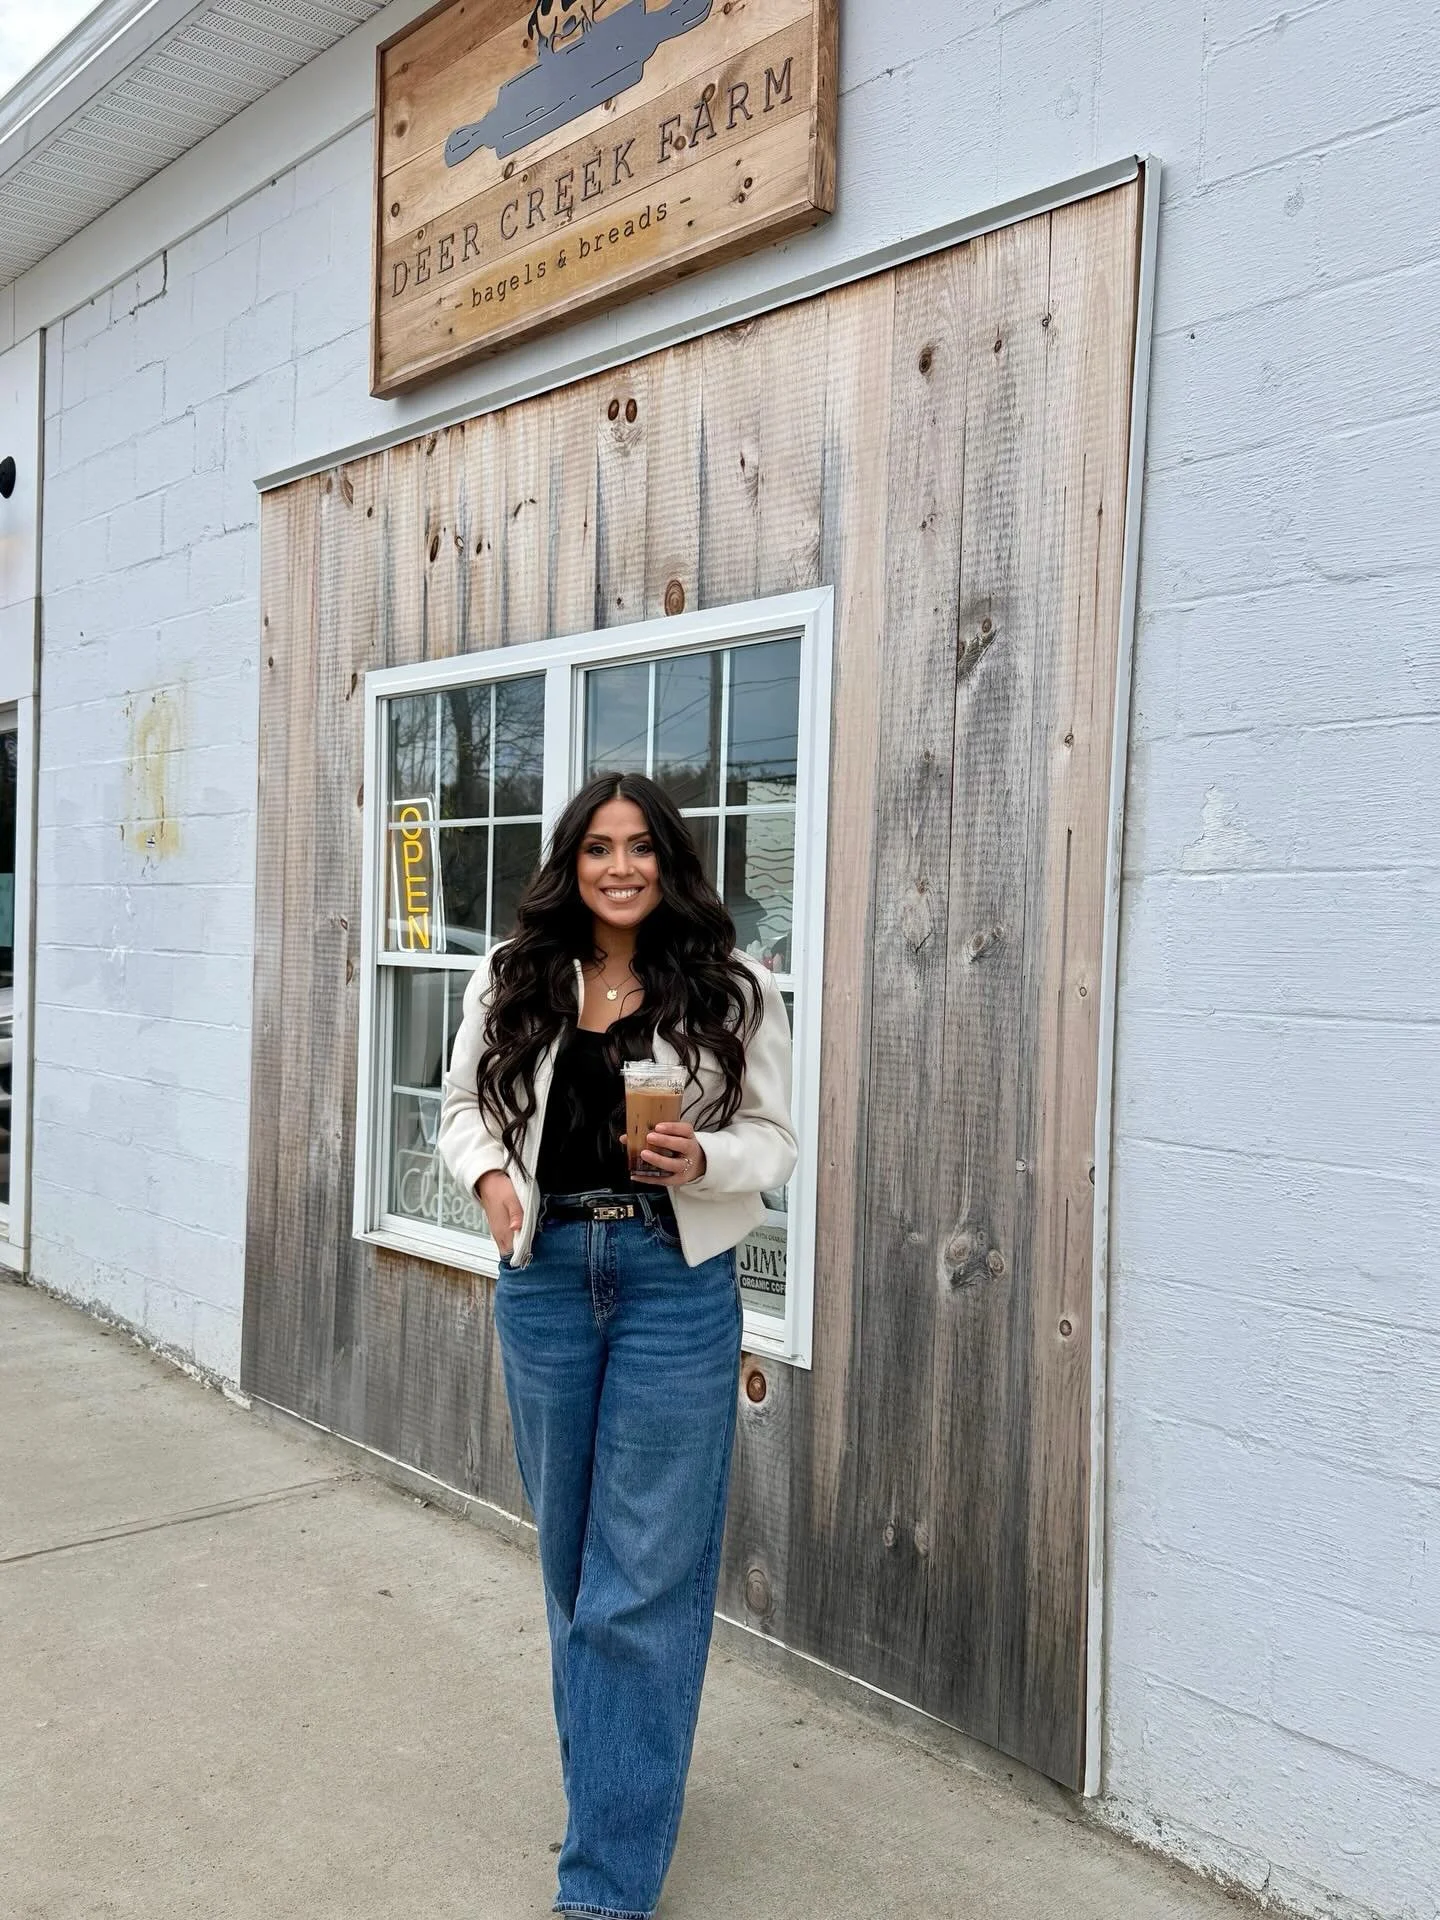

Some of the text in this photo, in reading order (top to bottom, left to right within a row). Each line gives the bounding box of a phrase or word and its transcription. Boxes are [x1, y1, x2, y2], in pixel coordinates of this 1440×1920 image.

[391, 56, 794, 298] DEER CREEK FARM
[471, 261, 546, 308] bagels
[558, 249, 567, 268] &
[579, 202, 667, 259] breads
[400, 806, 430, 950] OPEN
[740, 1243, 787, 1278] JIM'
[742, 1276, 770, 1291] ORGANIC
